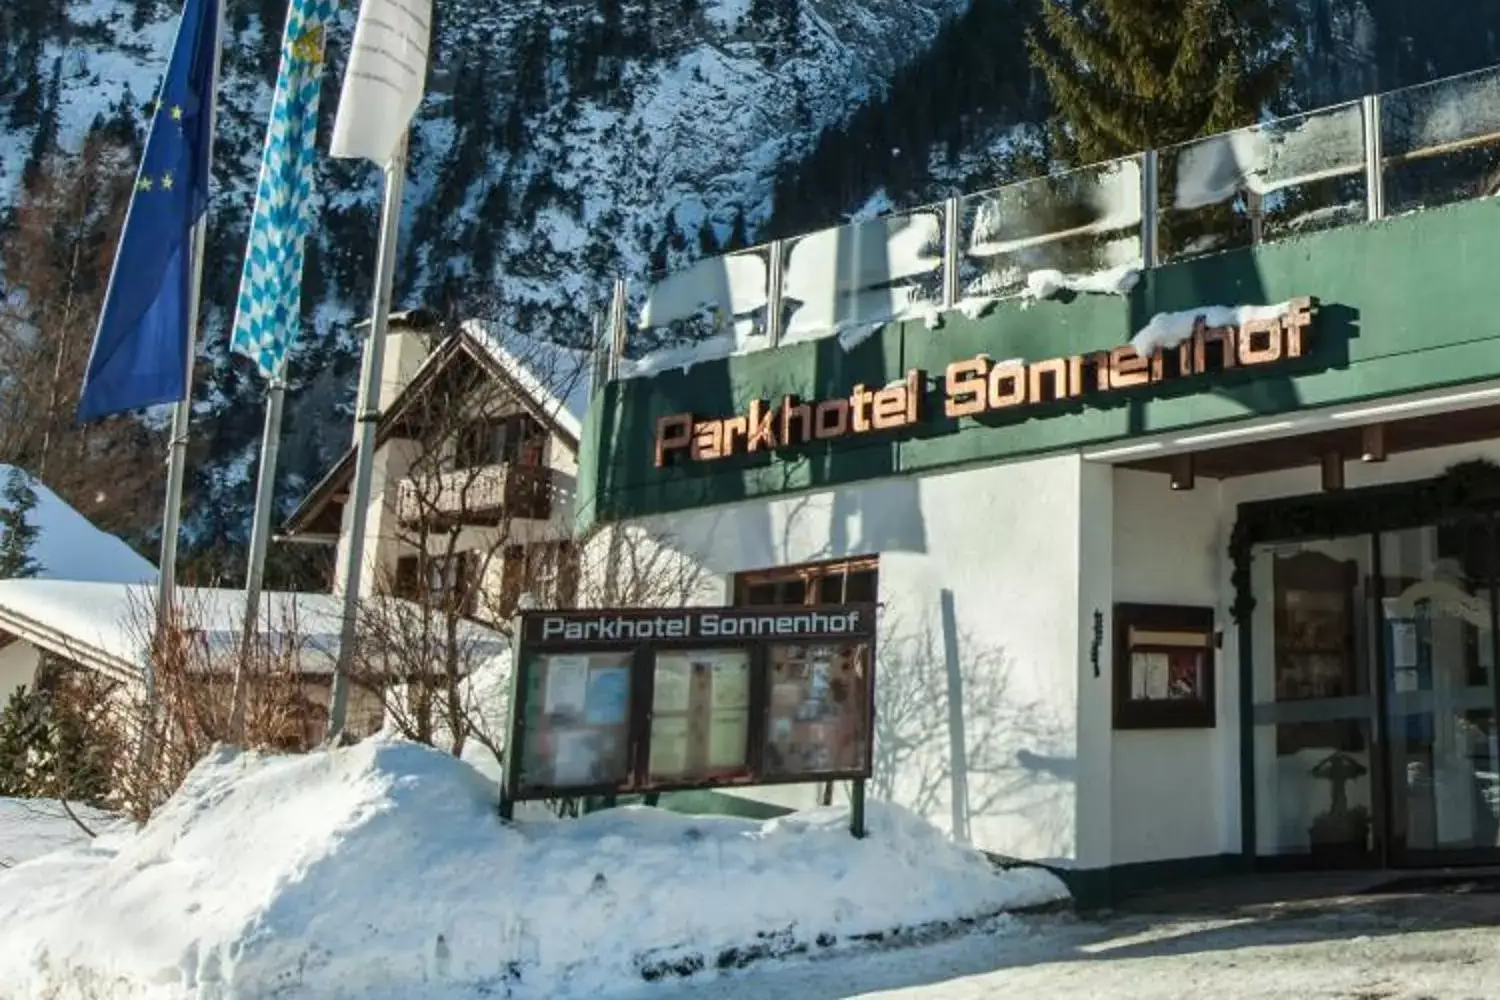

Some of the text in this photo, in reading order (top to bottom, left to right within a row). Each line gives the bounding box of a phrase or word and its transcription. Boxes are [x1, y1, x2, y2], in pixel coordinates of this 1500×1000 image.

[655, 296, 1320, 467] Parkhotel Sonnenhof
[542, 610, 859, 641] Parkhotel Sonnenhof
